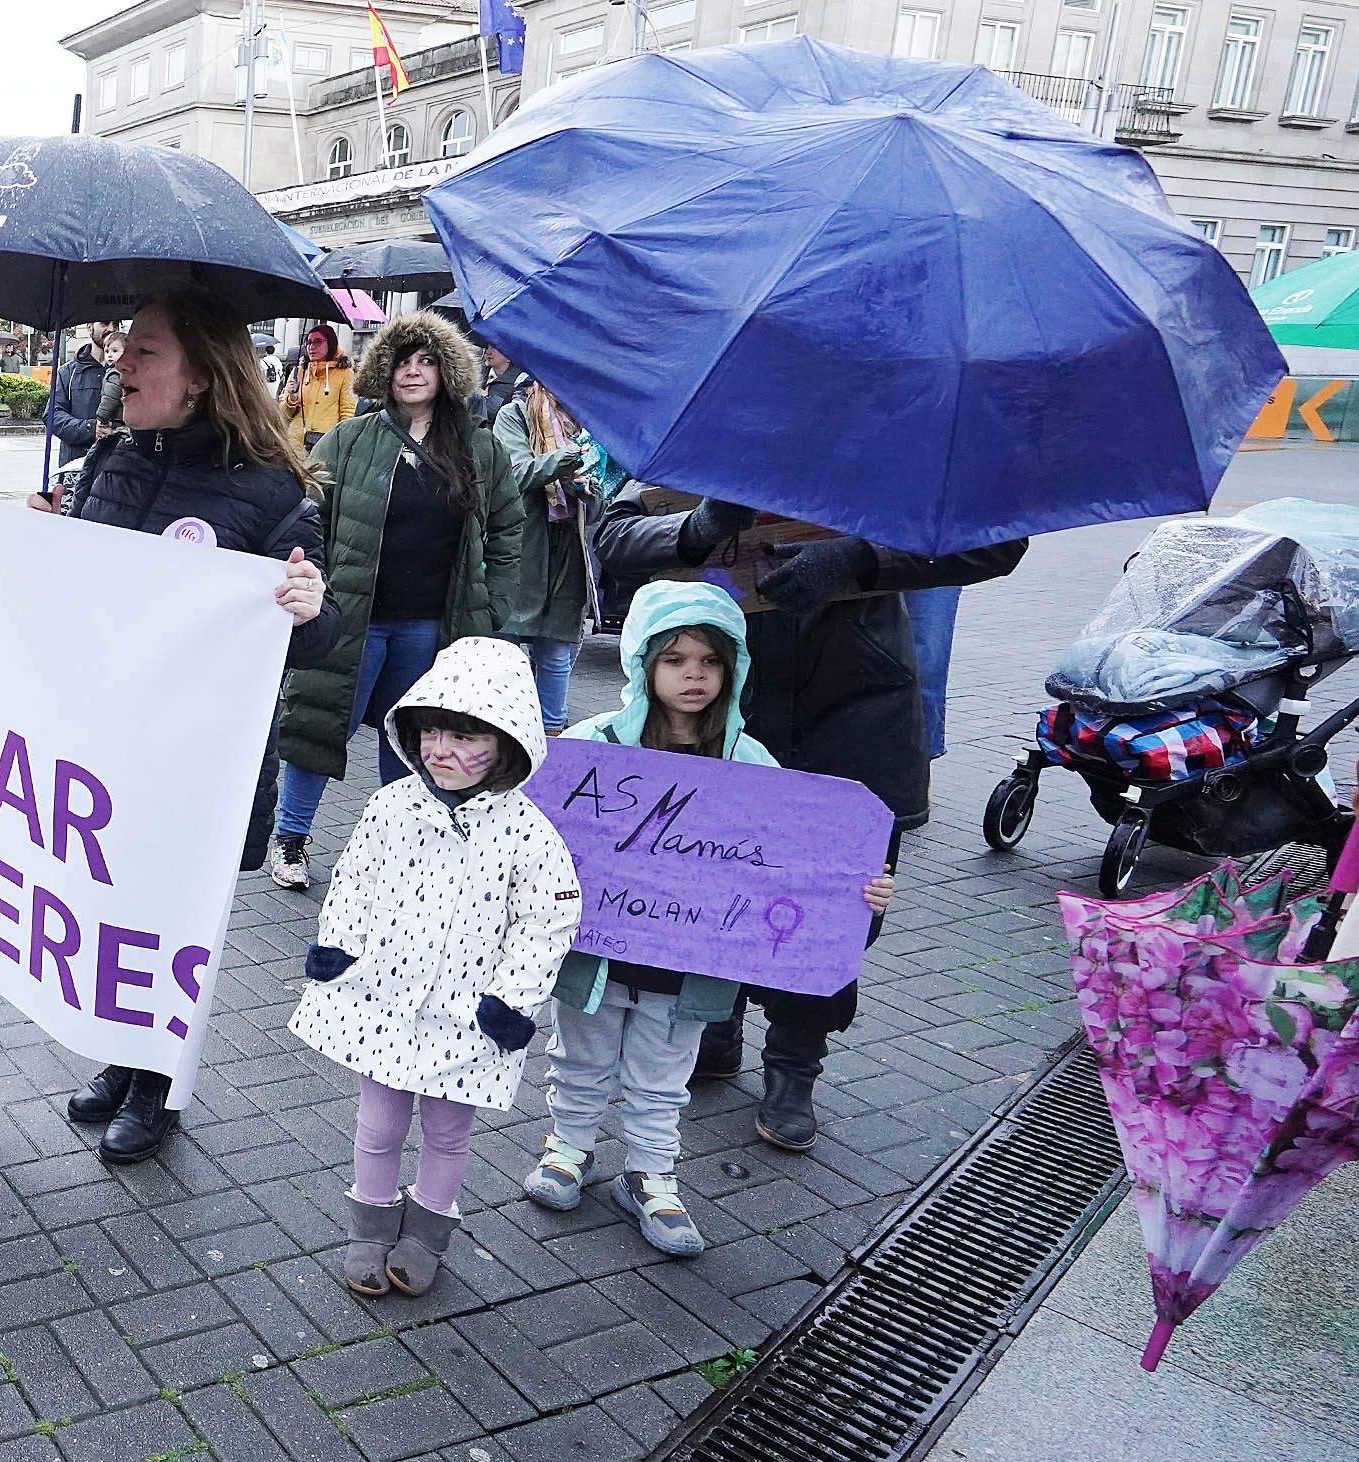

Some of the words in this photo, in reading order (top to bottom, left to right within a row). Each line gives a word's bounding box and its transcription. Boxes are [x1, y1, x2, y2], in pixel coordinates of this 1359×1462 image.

[281, 173, 388, 203] INTERNACIONAL
[393, 168, 413, 181] DE
[419, 165, 441, 177] LA
[562, 766, 643, 818] AS
[615, 782, 784, 868] Mamás
[598, 888, 702, 924] MOLAN
